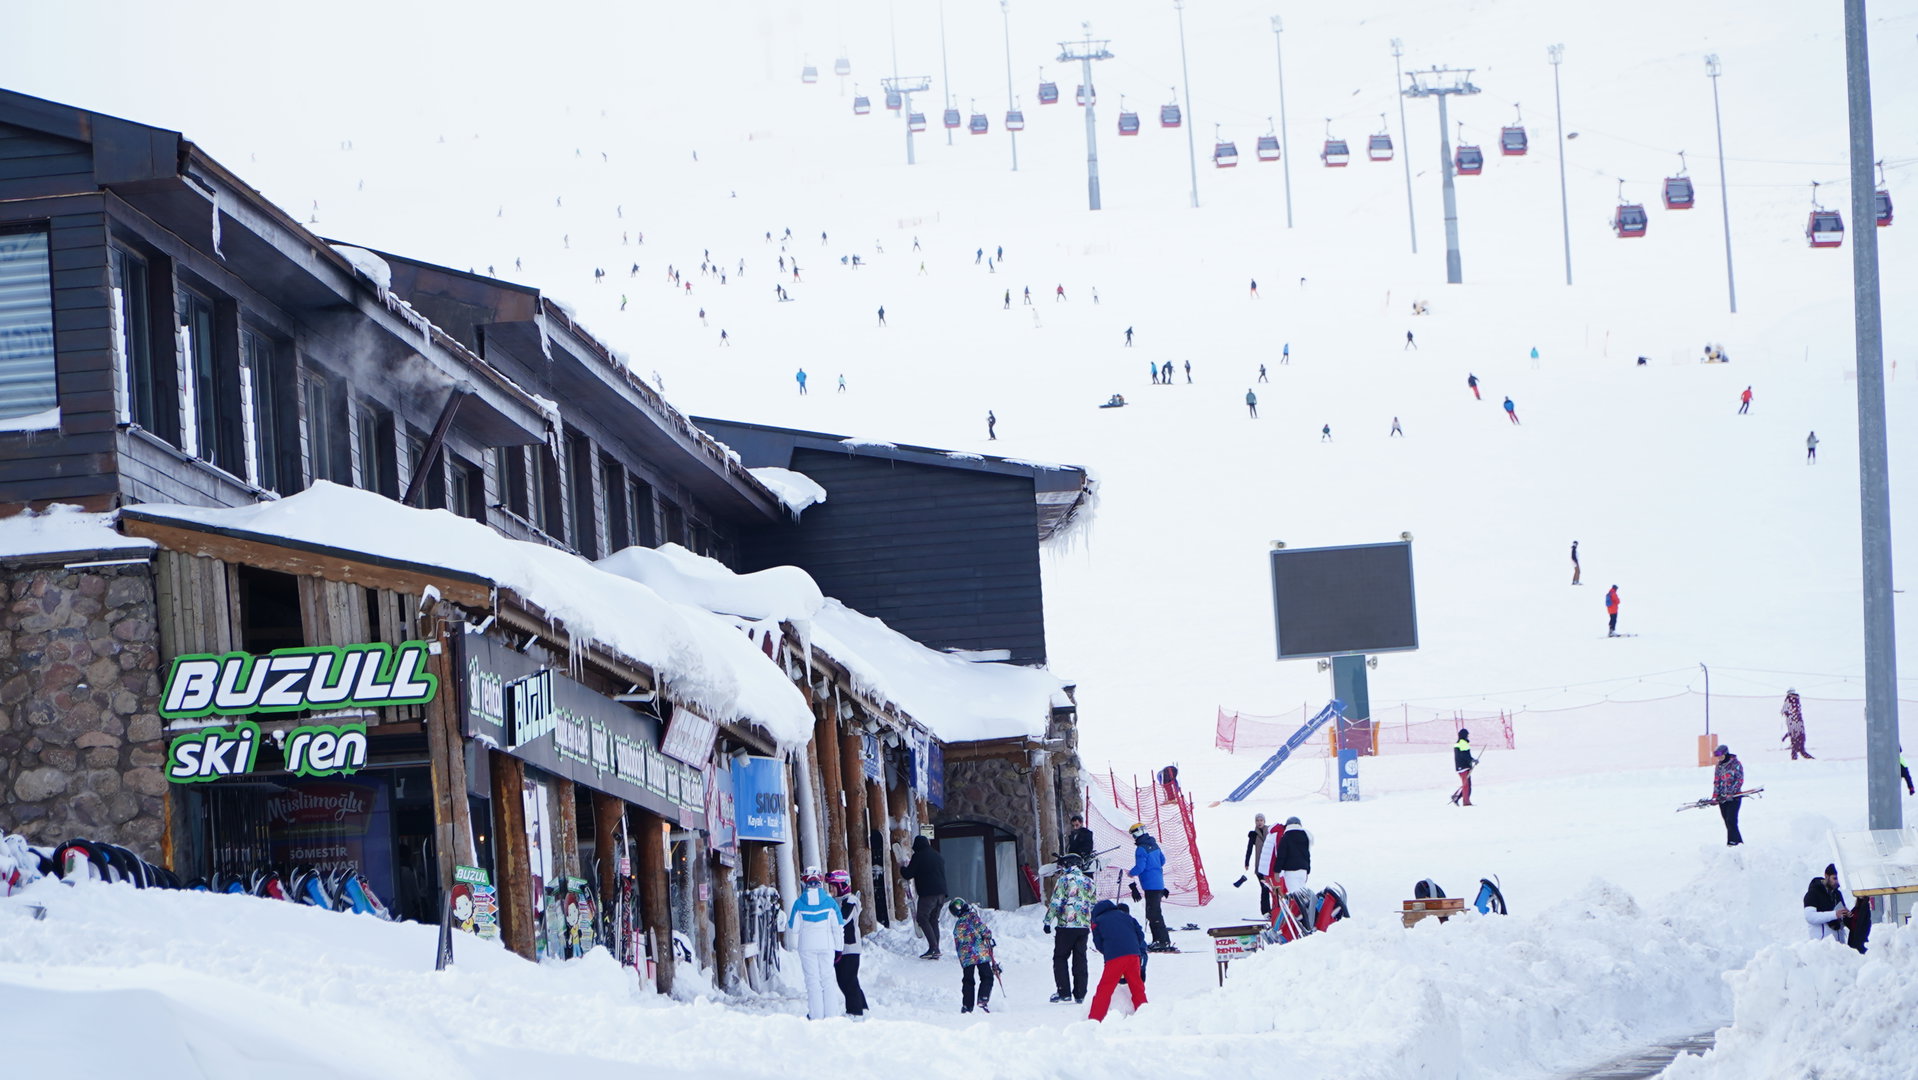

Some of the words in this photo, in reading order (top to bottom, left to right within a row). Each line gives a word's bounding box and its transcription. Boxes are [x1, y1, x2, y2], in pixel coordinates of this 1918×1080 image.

[165, 650, 429, 711] BUZULL
[171, 729, 253, 777] ski
[290, 845, 348, 860] SÖMESTİR
[456, 868, 486, 883] BUZUL
